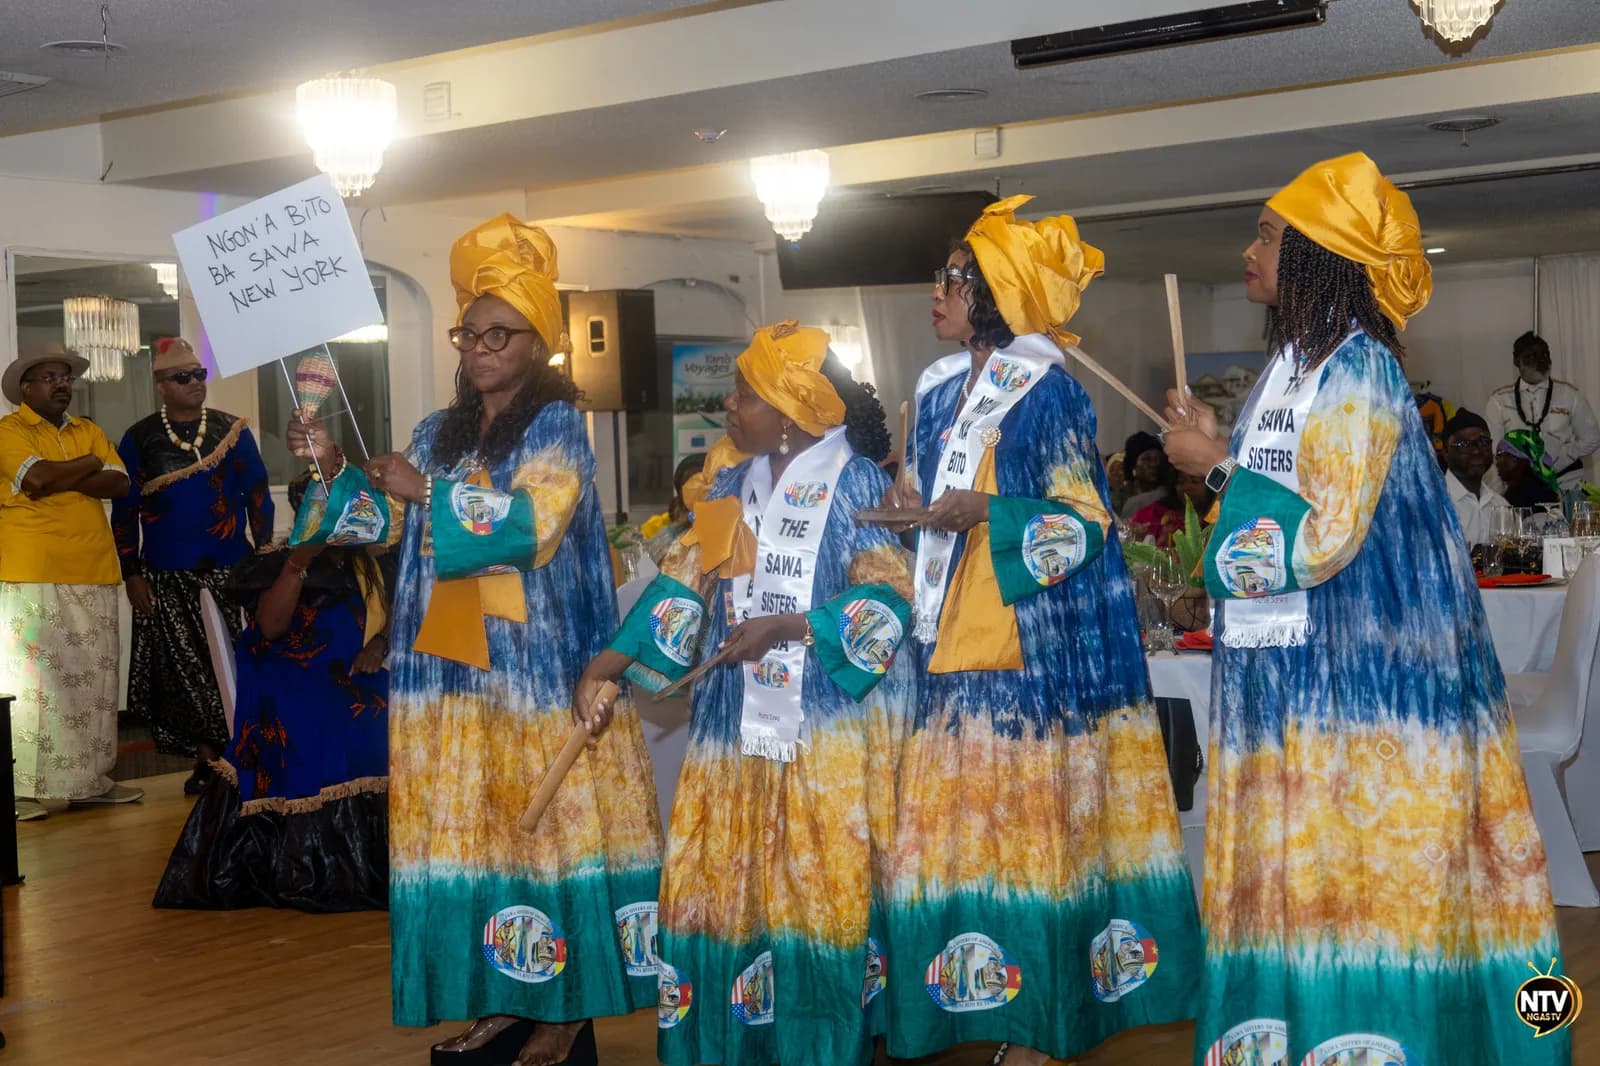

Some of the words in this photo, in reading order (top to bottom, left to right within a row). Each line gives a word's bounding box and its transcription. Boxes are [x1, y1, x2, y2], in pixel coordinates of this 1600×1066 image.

[208, 263, 236, 286] BA
[248, 229, 320, 272] SAWA
[228, 278, 277, 314] NEW
[281, 256, 348, 292] YORK
[1258, 408, 1295, 433] SAWA
[947, 450, 967, 475] BITO
[1247, 446, 1293, 472] SISTERS
[779, 517, 810, 538] THE
[765, 552, 803, 579] SAWA
[761, 591, 798, 614] SISTERS
